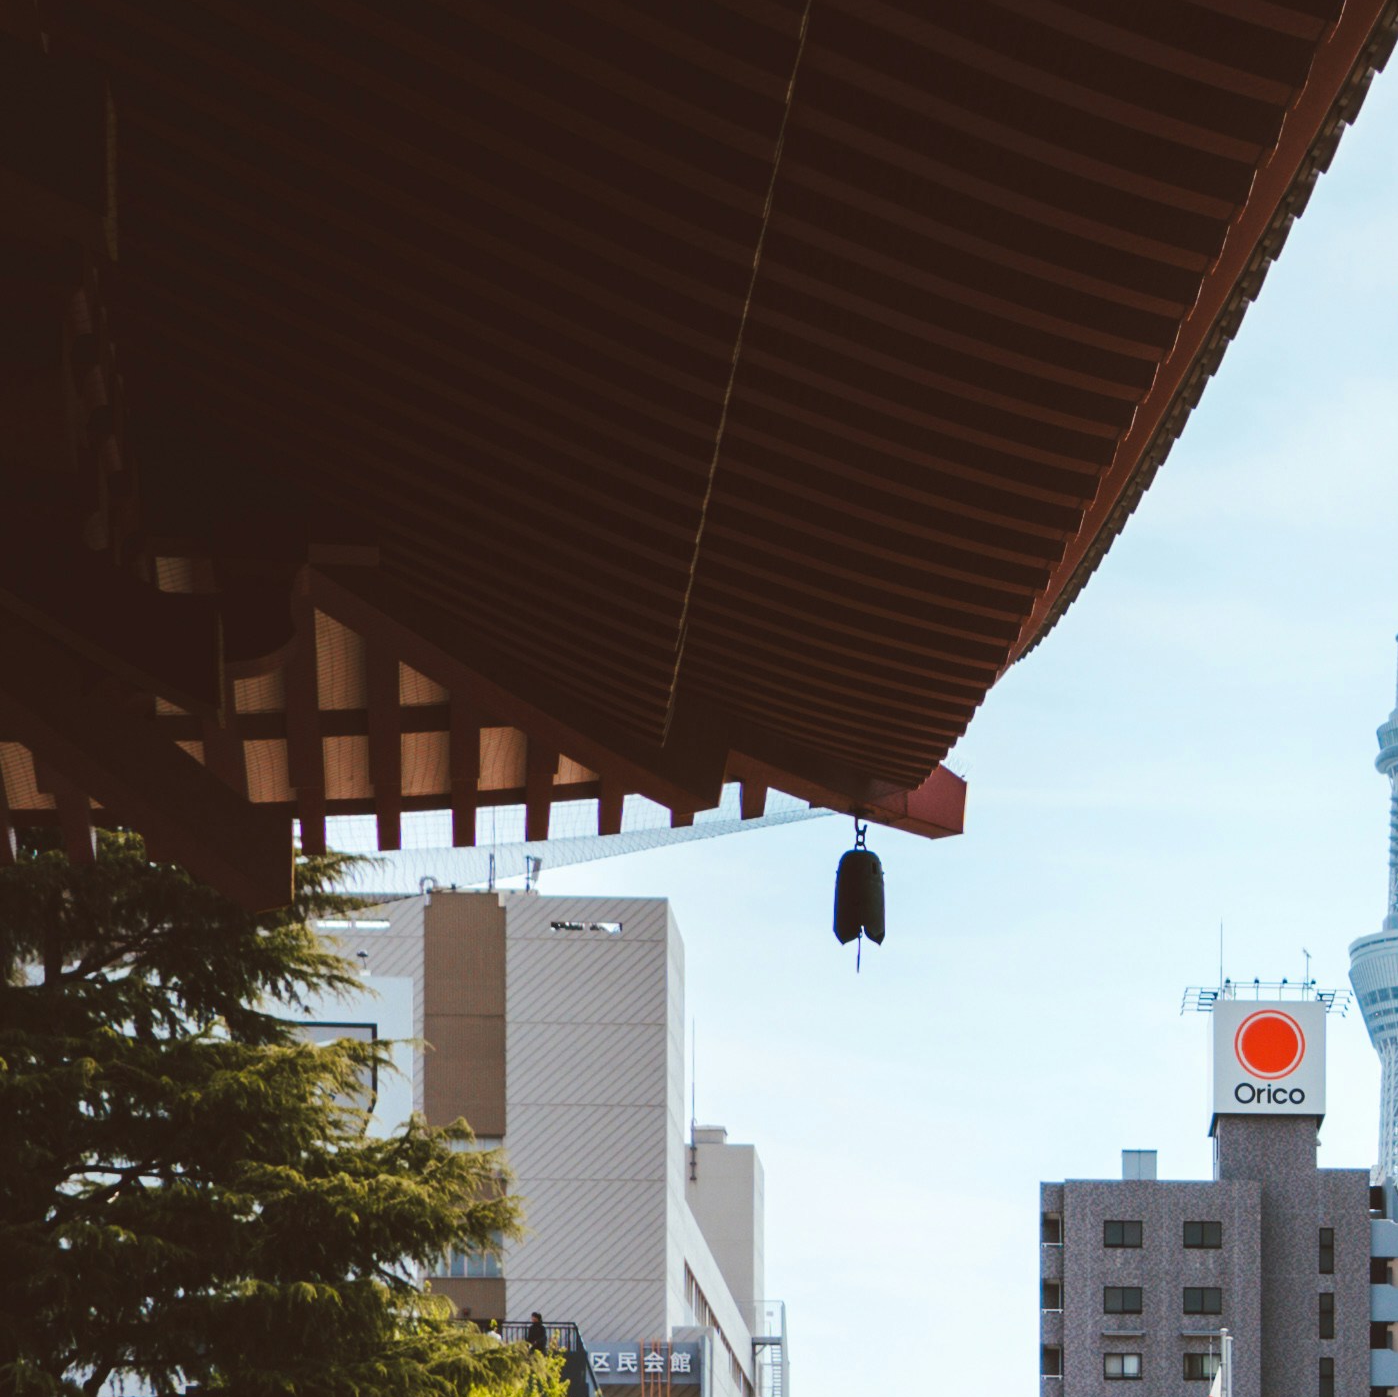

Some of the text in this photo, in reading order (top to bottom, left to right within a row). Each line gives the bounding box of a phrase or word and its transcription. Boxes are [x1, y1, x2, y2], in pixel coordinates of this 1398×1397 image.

[1234, 1082, 1306, 1105] Orico
[590, 1352, 691, 1373] 区民会館
